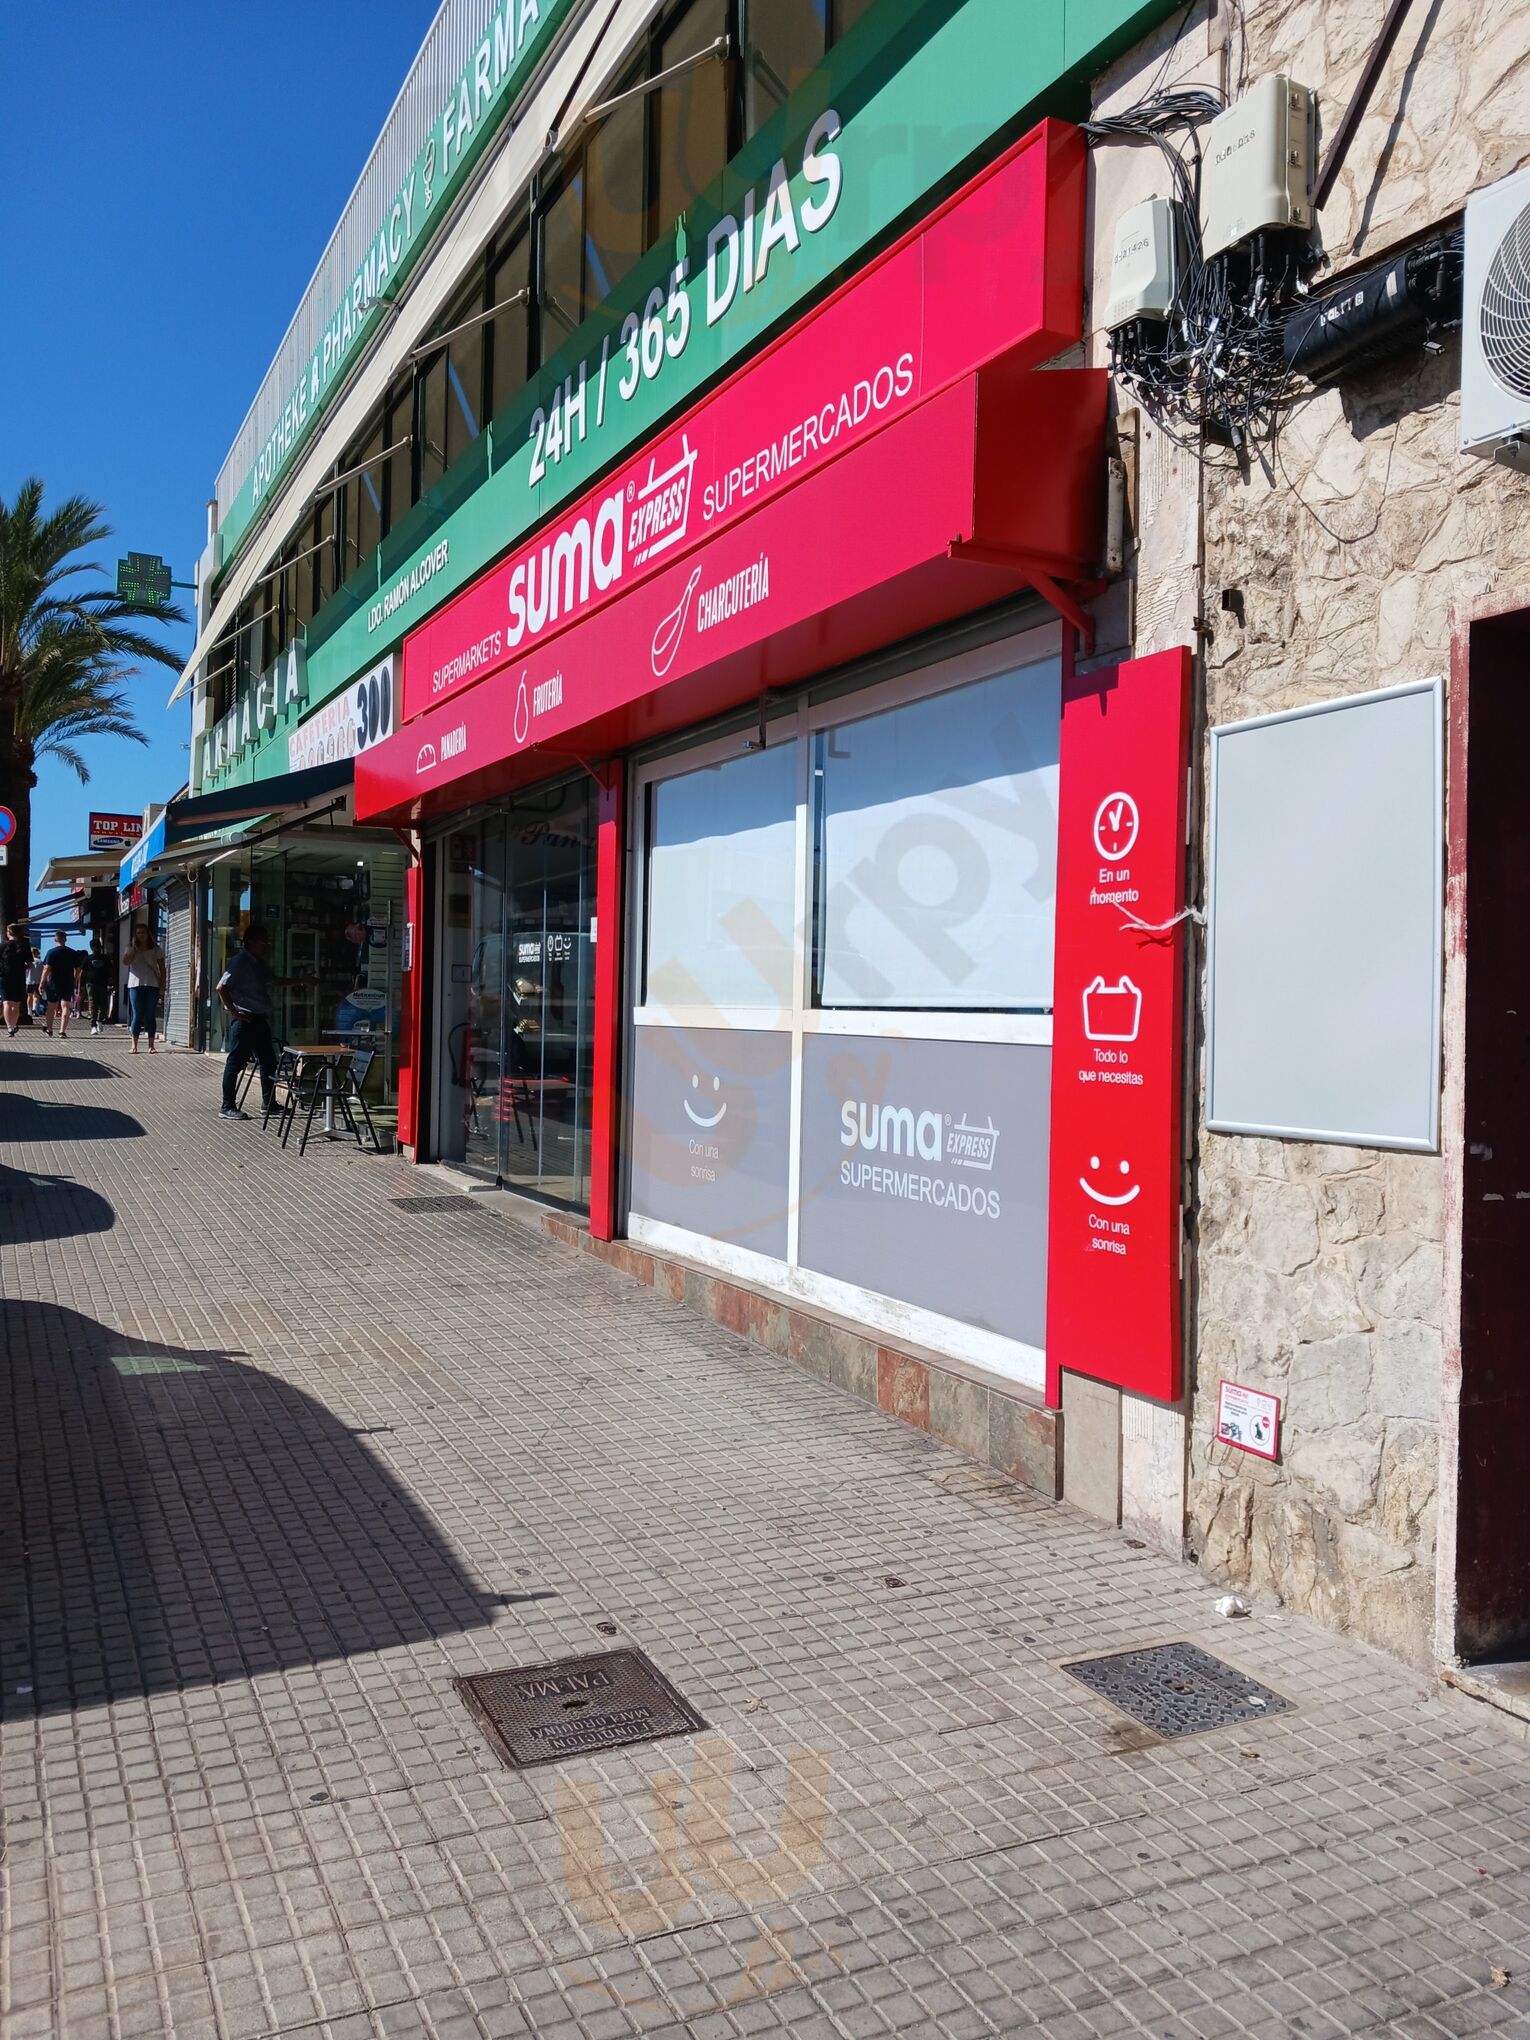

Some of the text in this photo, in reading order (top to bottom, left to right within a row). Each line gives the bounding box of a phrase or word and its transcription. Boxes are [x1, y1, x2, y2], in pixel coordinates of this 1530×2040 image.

[529, 360, 588, 488] 24H
[619, 257, 691, 401] 365
[706, 109, 842, 328] DIAS
[252, 374, 307, 505] APOTHEKE
[323, 173, 416, 384] PHARMACY
[433, 353, 914, 694] SUPERMARKETS suma EXPRESS SUPERMERCADOS
[367, 539, 450, 633] LDO. RAMÓN ALCOVER
[697, 552, 769, 633] CHARCUTERÍA
[357, 665, 391, 750] 300
[533, 669, 563, 718] FRUTERÍA
[440, 721, 467, 762] PANADERÍA
[93, 820, 118, 831] TOP
[1099, 868, 1130, 883] En un
[1090, 888, 1139, 905] momento
[1093, 1048, 1128, 1064] Todo lo
[1079, 1070, 1143, 1085] que necesitas
[689, 1139, 719, 1159] Con una
[840, 1100, 991, 1161] suma EXPRESS
[690, 1165, 716, 1181] sonrisa
[840, 1160, 1000, 1219] SUPERMERCADOS
[1088, 1213, 1130, 1235] Con una
[1092, 1238, 1126, 1255] sonrisa
